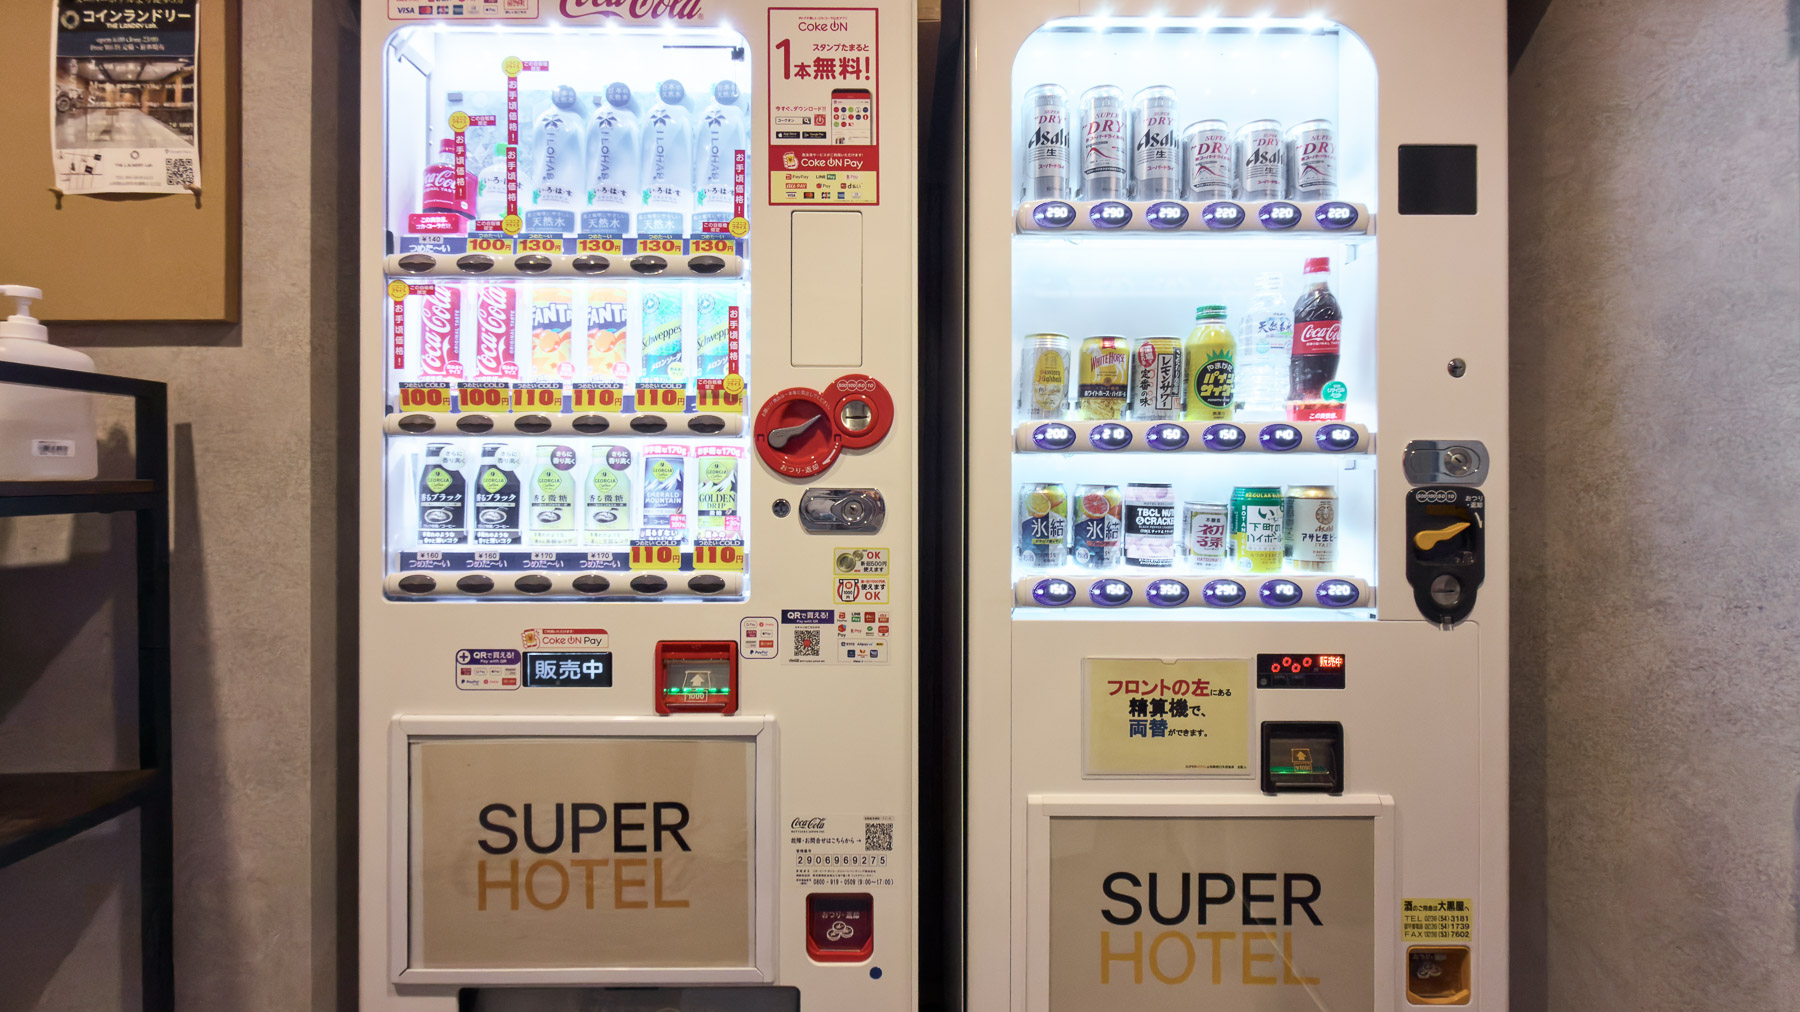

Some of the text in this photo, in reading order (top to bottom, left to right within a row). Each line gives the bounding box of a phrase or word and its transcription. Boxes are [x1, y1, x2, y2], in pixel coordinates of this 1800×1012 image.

[83, 9, 191, 23] コインランドリー
[798, 20, 848, 32] Coke ON
[812, 44, 870, 52] スタンプたまると
[1038, 115, 1064, 124] DRY
[1147, 116, 1172, 126] DRY
[1088, 120, 1124, 135] DRY
[1258, 138, 1280, 146] DRY
[1046, 148, 1057, 157] 生
[1156, 150, 1166, 158] 生
[801, 158, 864, 170] Coke ON Pay
[1046, 208, 1068, 218] 290
[1102, 208, 1124, 218] 290
[1158, 208, 1180, 218] 290
[1215, 208, 1237, 218] 220
[1271, 208, 1293, 218] 220
[1328, 208, 1350, 218] 220
[532, 217, 566, 227] 天然水
[588, 218, 620, 228] 天然水
[644, 219, 674, 230] 天然水
[470, 239, 512, 250] 100円
[520, 240, 561, 252] 130円
[579, 240, 620, 252] 130円
[640, 240, 681, 252] 130円
[692, 240, 734, 252] 130円
[1090, 356, 1108, 372] WHITE
[1108, 352, 1124, 364] HORSE
[1206, 362, 1233, 372] やまがた
[1140, 368, 1150, 407] 定番の味
[1160, 356, 1172, 408] レモンサワー
[401, 388, 450, 406] 100円
[459, 388, 508, 406] 100円
[514, 389, 562, 406] 110円
[574, 390, 622, 406] 110円
[636, 390, 684, 406] 110円
[1045, 428, 1068, 440] 200
[1163, 428, 1180, 440] 150
[1219, 428, 1237, 440] 150
[1332, 428, 1350, 440] 160
[780, 463, 819, 474] おつり・返却
[422, 493, 462, 502] 香るブラック
[476, 493, 516, 502] 香るブラック
[534, 494, 568, 502] 香る微糖
[590, 494, 624, 502] 香る微糖
[699, 494, 736, 502] GOLDEN
[1137, 508, 1160, 516] TBCL
[1032, 518, 1065, 538] 氷結
[1086, 520, 1120, 540] 氷結
[632, 546, 680, 564] 110円
[696, 546, 744, 564] 110円
[1050, 584, 1068, 594] 150
[1106, 584, 1124, 594] 150
[1160, 584, 1180, 594] 350
[1215, 584, 1236, 594] 290
[1328, 584, 1350, 594] 220
[864, 592, 880, 600] OK
[542, 636, 602, 646] Coke ON Pay
[474, 652, 514, 660] QRで買える!
[1320, 656, 1343, 667] 販売中
[535, 659, 603, 680] 販売中
[1108, 678, 1232, 696] フロントの左にある
[1128, 698, 1206, 718] 精算機で、
[1129, 718, 1208, 738] 両替ができます。
[478, 802, 692, 854] SUPER
[791, 817, 826, 829] Coca-Cola
[798, 856, 886, 864] 2906969275
[478, 858, 690, 910] HOTEL
[1101, 872, 1324, 926] SUPER
[1404, 900, 1470, 911] 酒のご用命は大黒屋へ
[1100, 930, 1320, 984] HOTEL
